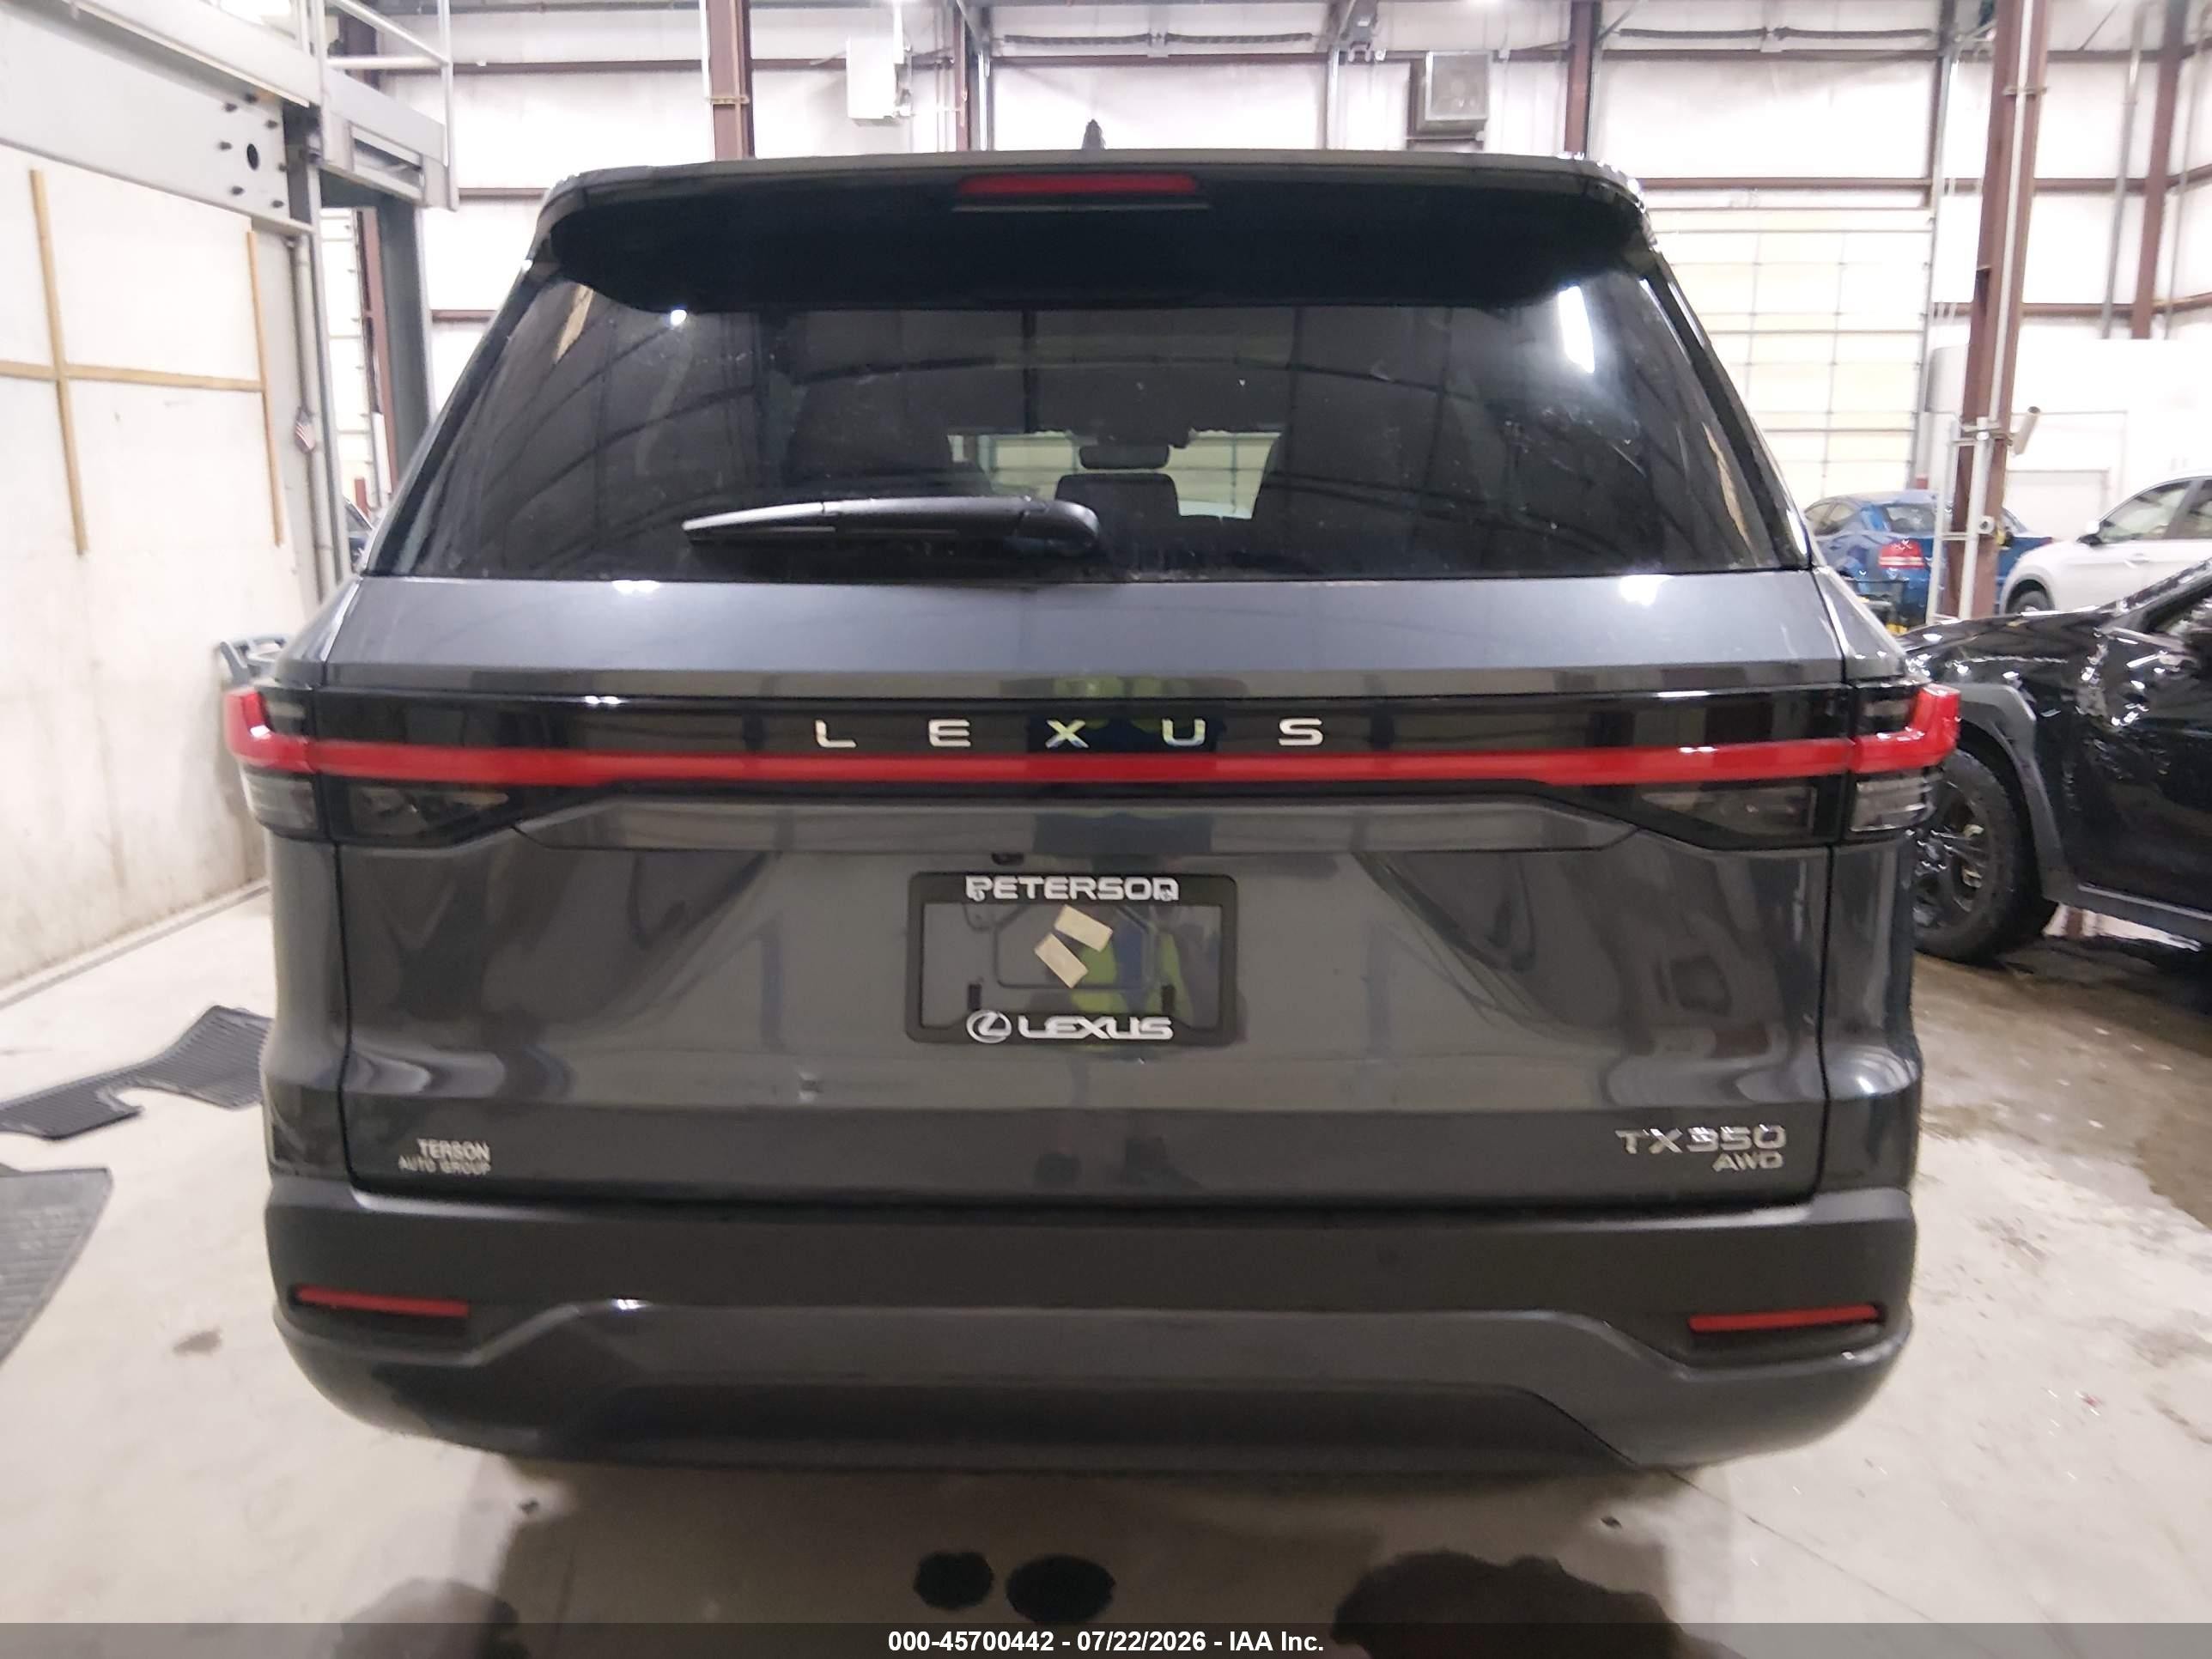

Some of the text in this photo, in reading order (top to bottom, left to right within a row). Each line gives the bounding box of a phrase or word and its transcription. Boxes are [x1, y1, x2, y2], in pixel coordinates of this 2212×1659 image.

[815, 718, 1325, 750] LEXUS
[1018, 1015, 1174, 1041] LEXUS
[416, 1138, 491, 1163] TERSON
[1712, 1151, 1784, 1173] AWD
[398, 1154, 491, 1176] AUTO GROUP
